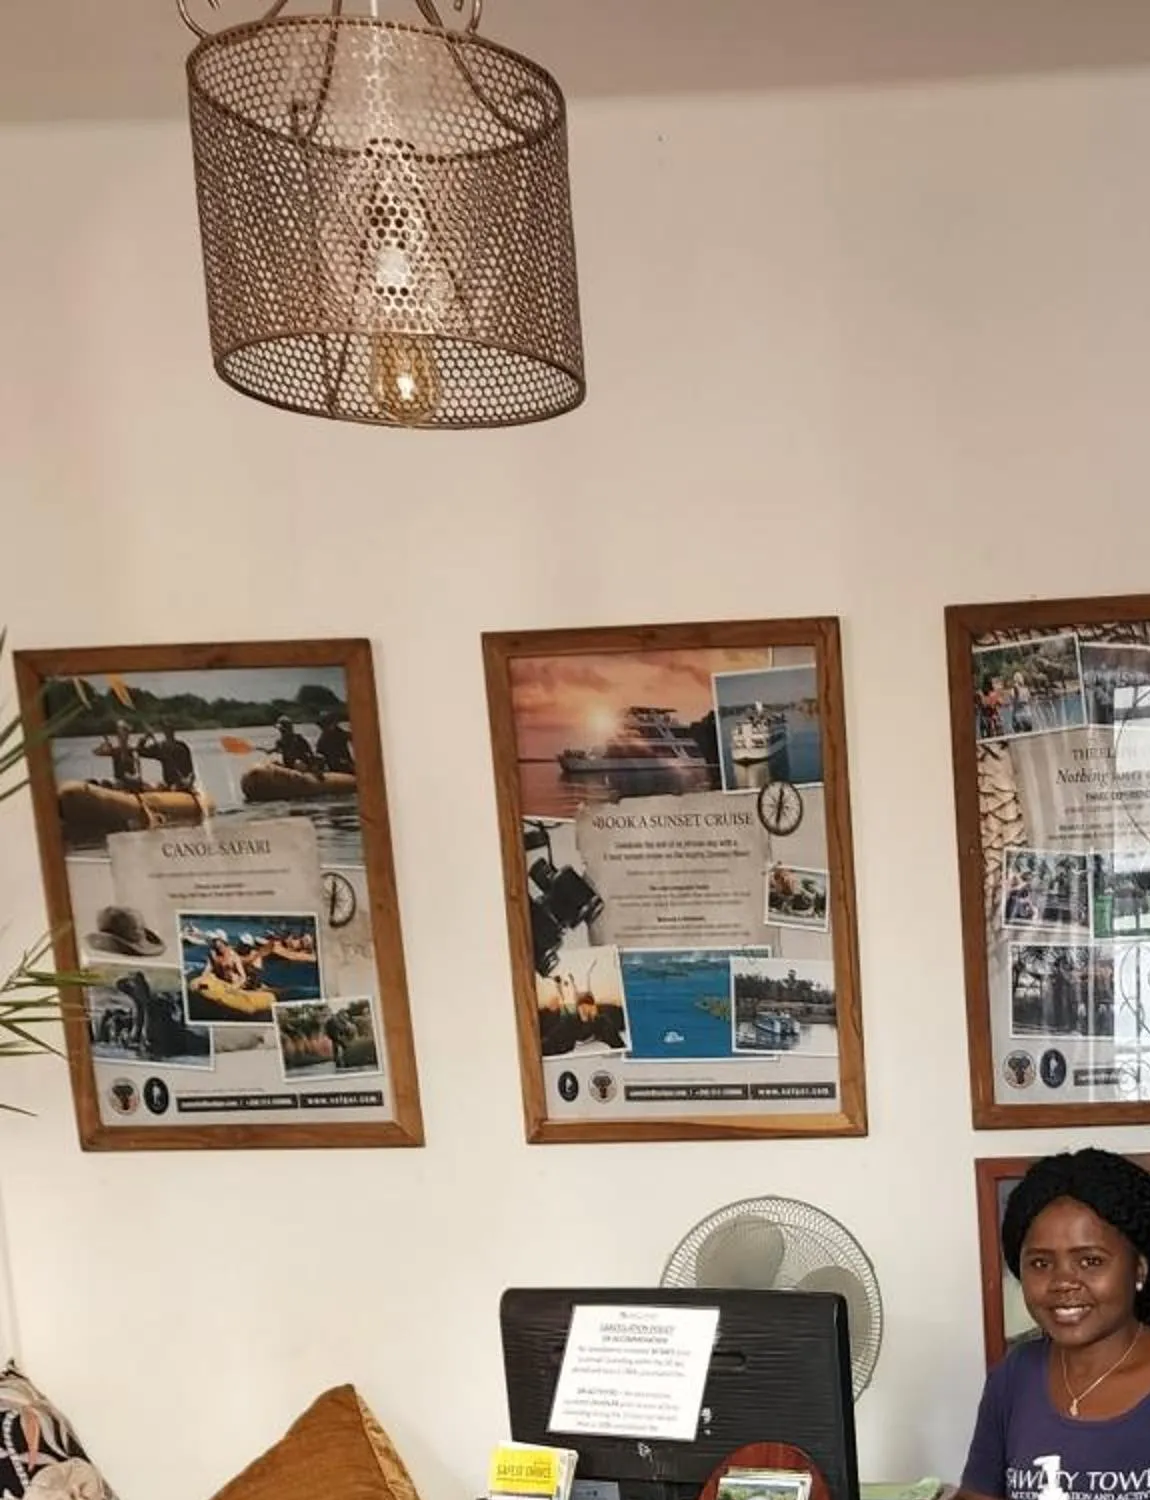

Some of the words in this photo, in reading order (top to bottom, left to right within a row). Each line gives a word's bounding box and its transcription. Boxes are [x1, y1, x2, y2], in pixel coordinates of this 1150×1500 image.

[649, 813, 702, 829] SUNSET
[703, 811, 752, 828] CRUISE
[219, 839, 272, 856] SAFARI
[1007, 1467, 1080, 1491] AWLY
